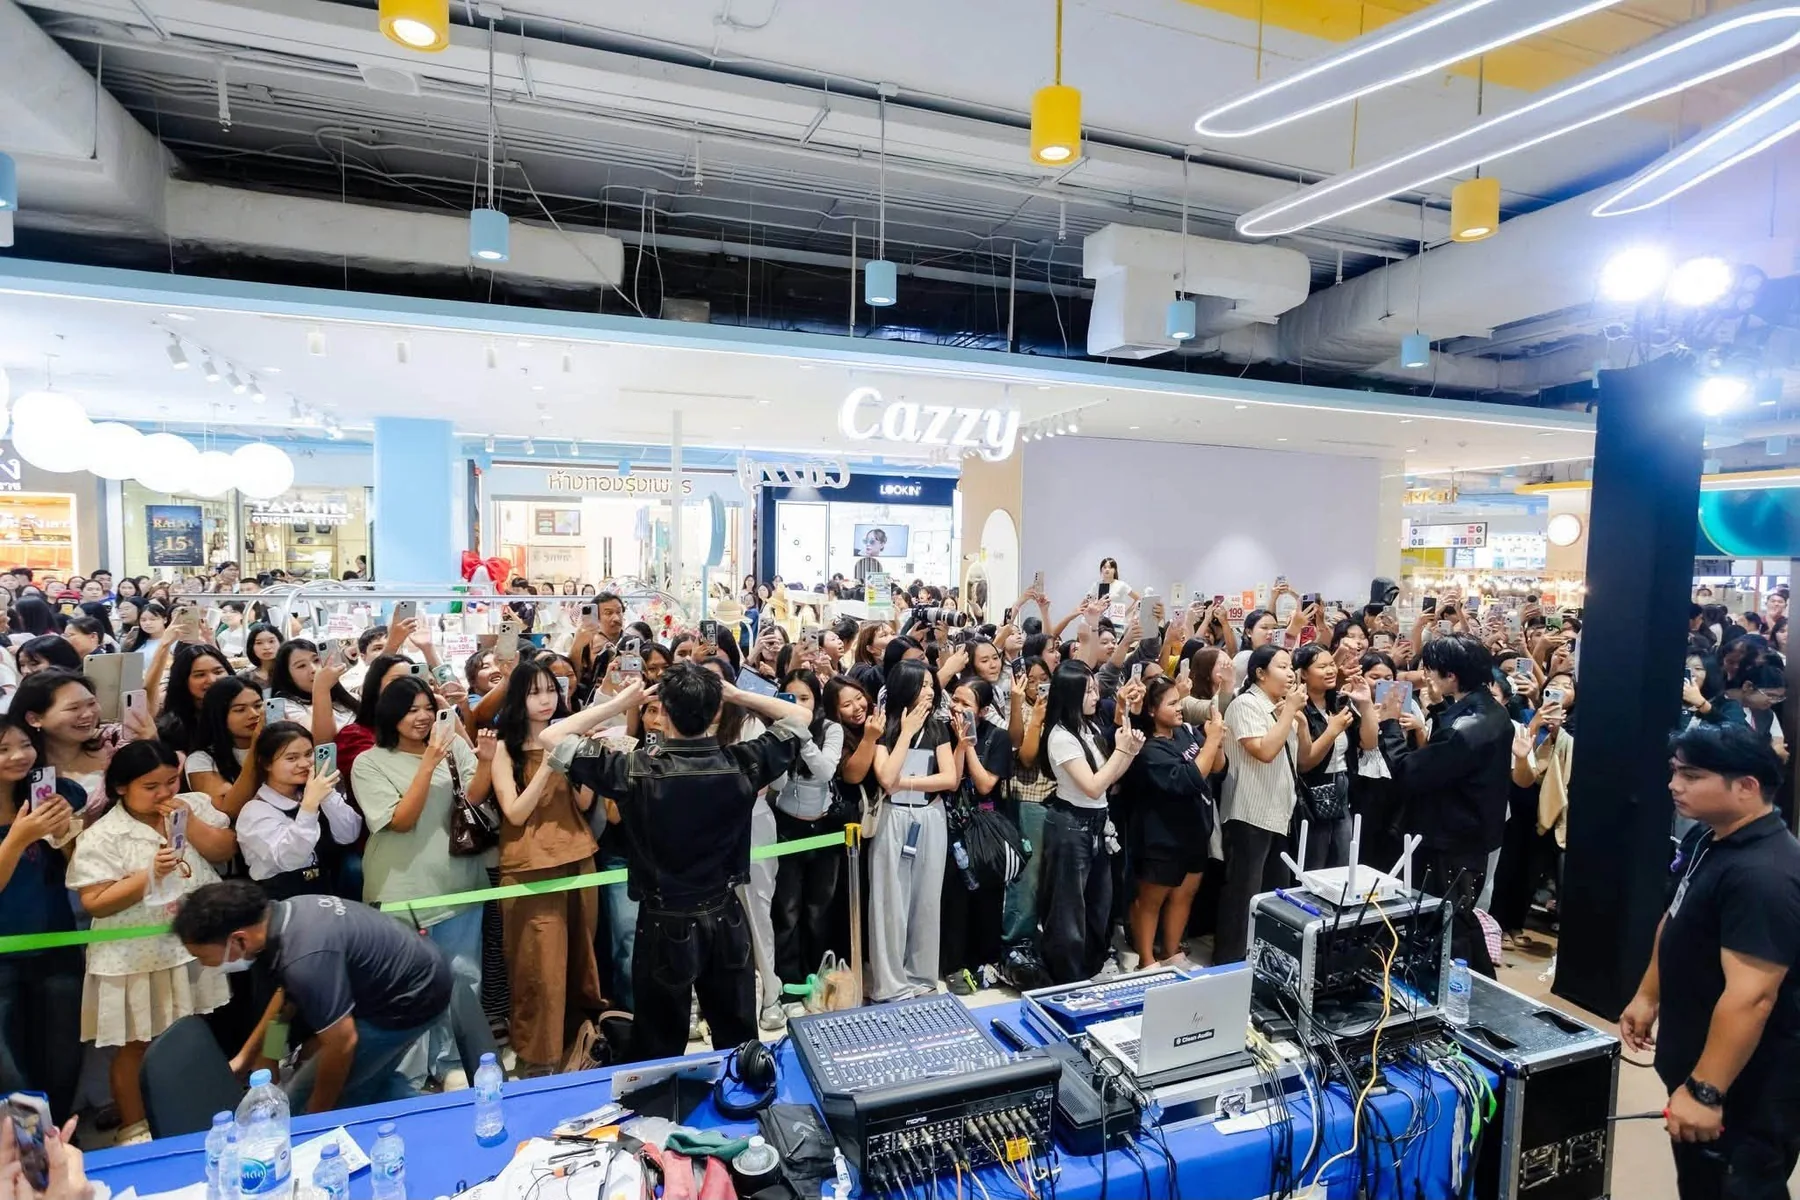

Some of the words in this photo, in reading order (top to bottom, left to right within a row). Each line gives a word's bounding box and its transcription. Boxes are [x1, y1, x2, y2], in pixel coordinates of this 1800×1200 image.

[839, 387, 1020, 461] Cazzy
[549, 470, 692, 497] ห้างทองรุ้งเพร
[253, 500, 347, 513] TAYWIN
[252, 516, 307, 525] ORIGINAL
[314, 517, 347, 525] STYLE
[1228, 607, 1243, 618] 199
[1198, 1032, 1212, 1040] Audio
